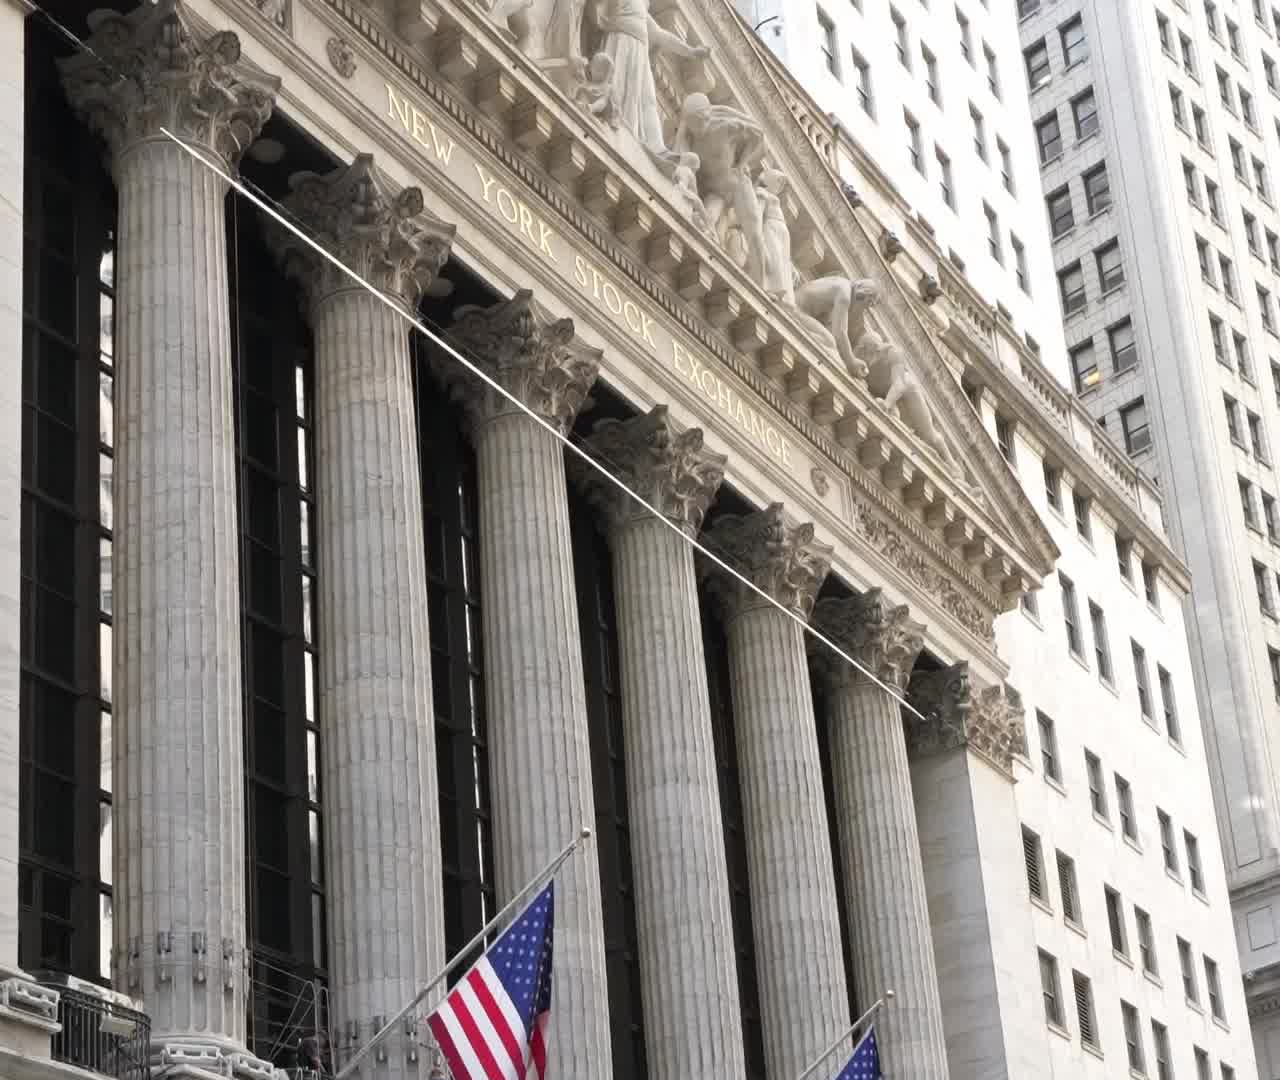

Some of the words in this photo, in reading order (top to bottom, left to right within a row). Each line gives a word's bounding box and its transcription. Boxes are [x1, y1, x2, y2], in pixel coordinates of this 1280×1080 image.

[384, 84, 456, 166] NEW
[474, 163, 558, 262] YORK
[574, 255, 657, 348] STOCK
[672, 339, 794, 468] EXCHANGE
